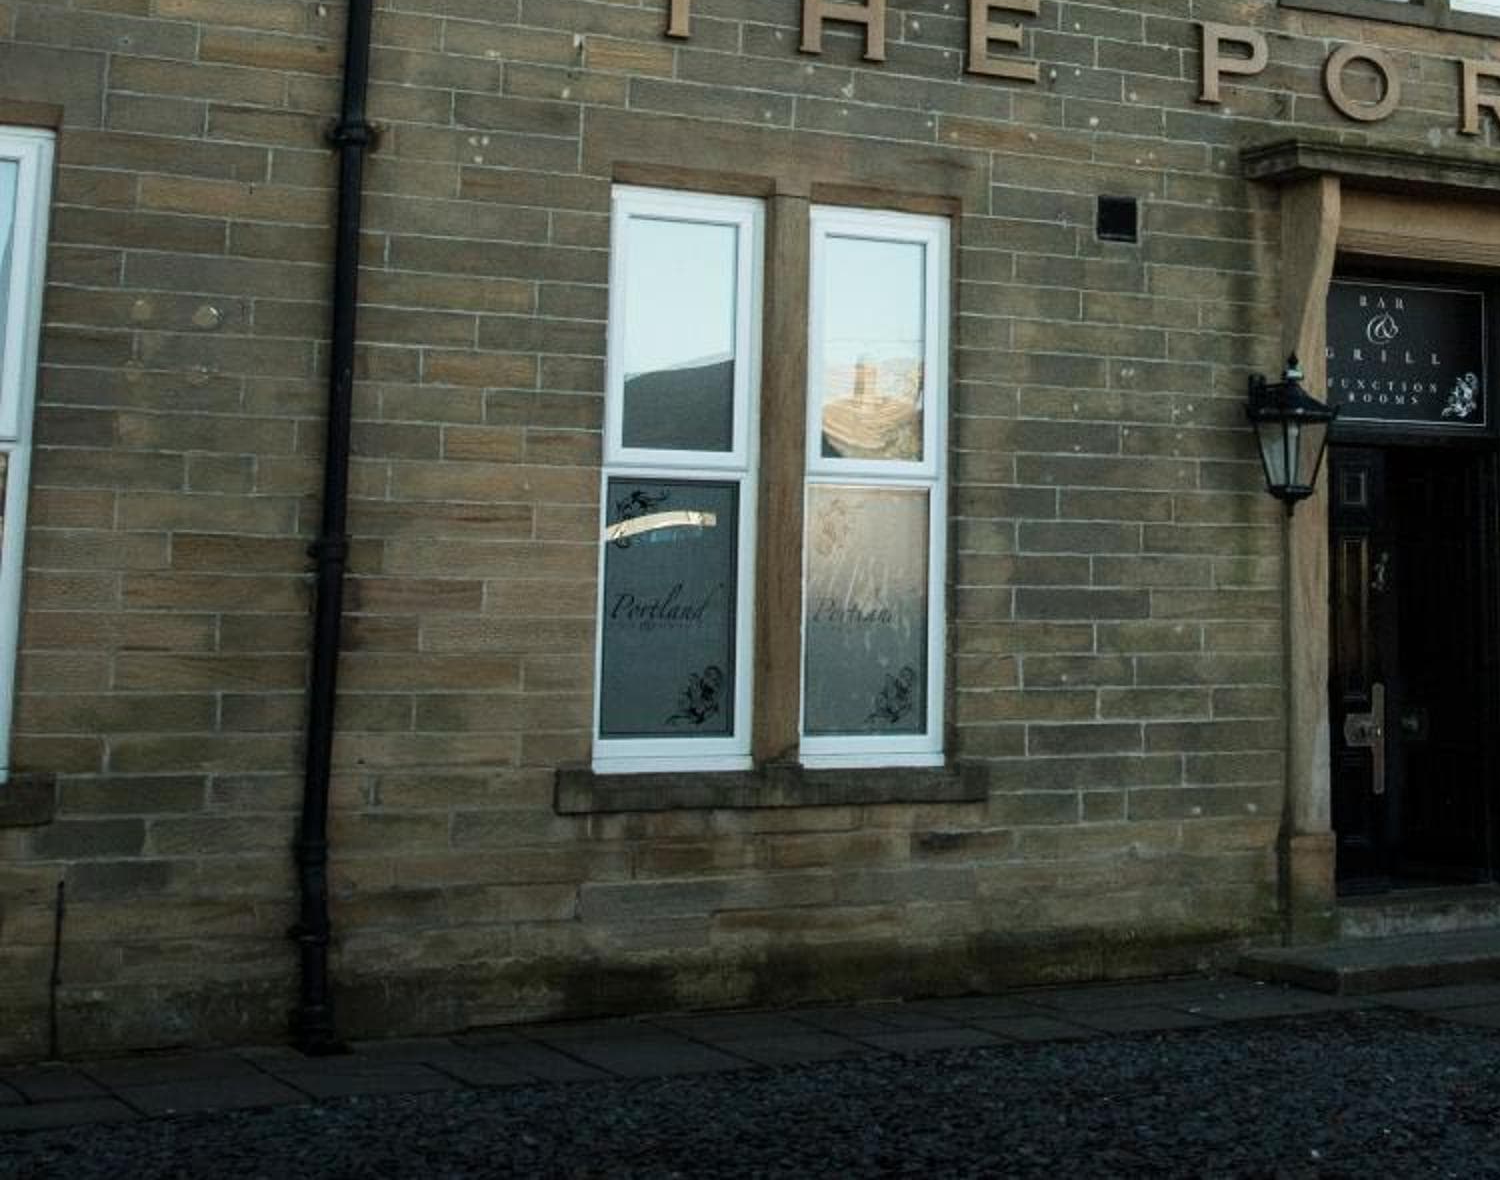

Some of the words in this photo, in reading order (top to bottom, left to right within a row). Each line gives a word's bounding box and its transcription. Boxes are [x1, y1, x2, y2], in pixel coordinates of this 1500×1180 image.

[1359, 295, 1404, 310] BAR
[1325, 347, 1441, 365] GRILL
[1327, 377, 1438, 394] FUNCTION
[611, 581, 716, 620] Portland
